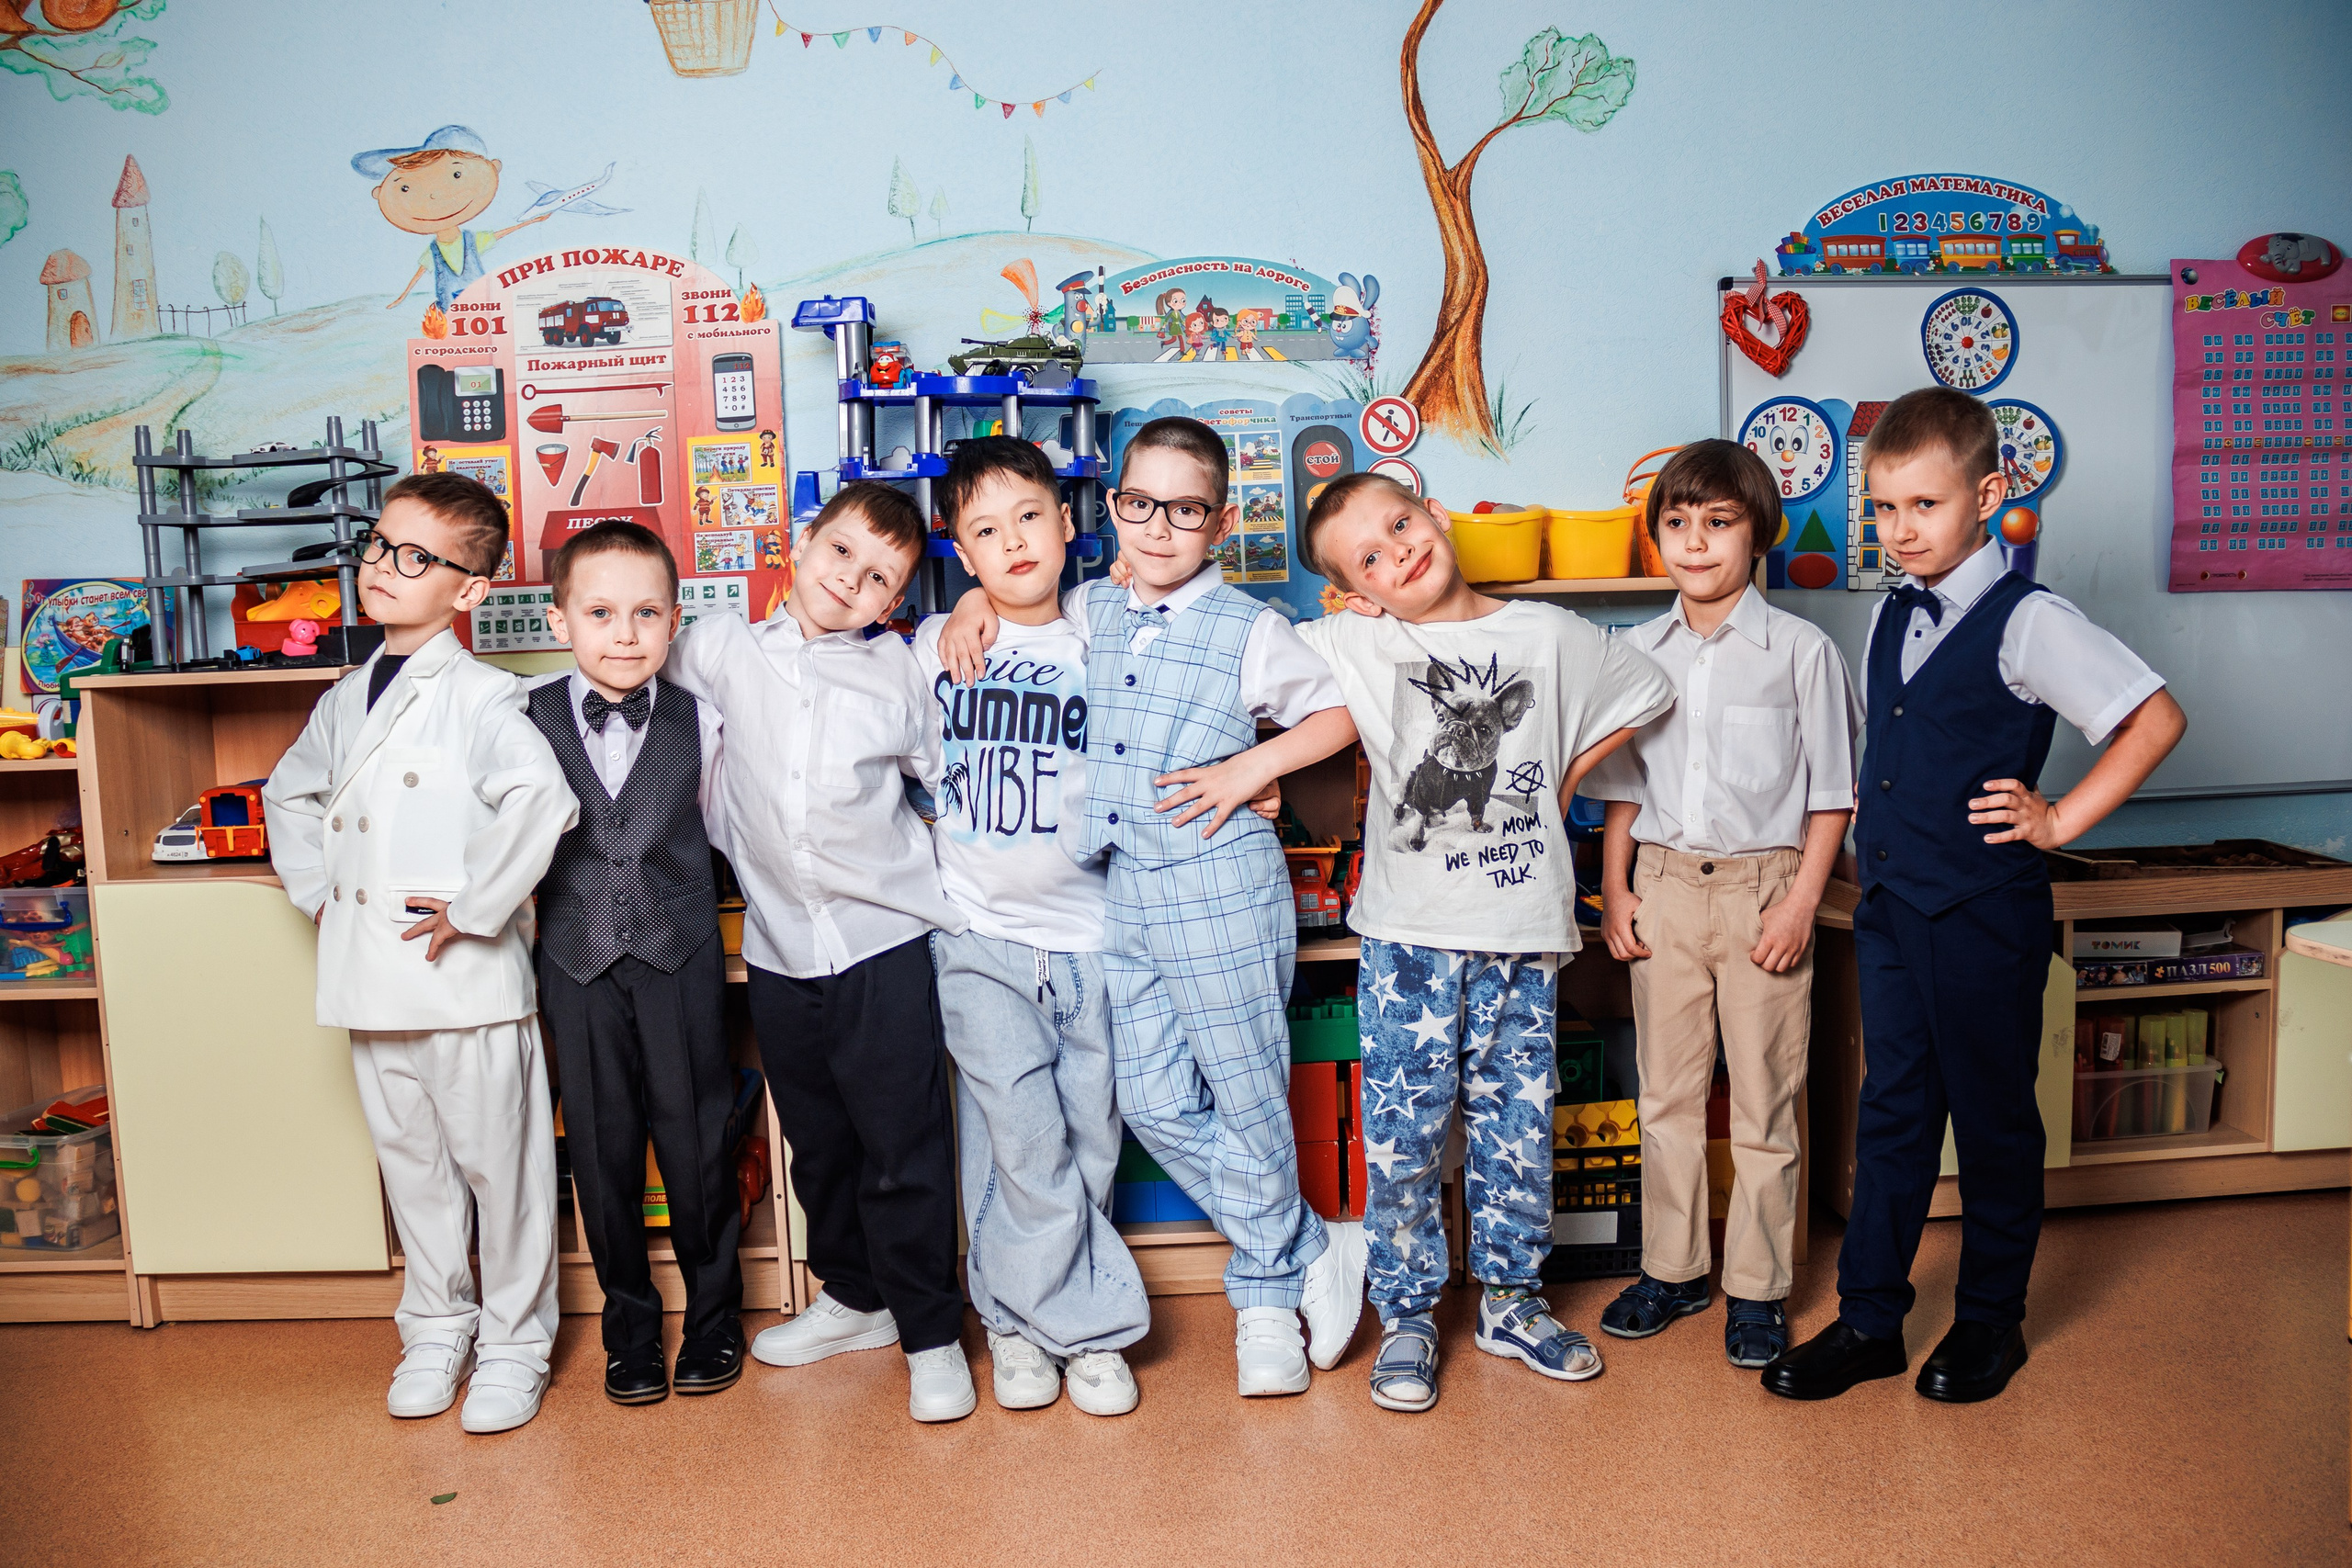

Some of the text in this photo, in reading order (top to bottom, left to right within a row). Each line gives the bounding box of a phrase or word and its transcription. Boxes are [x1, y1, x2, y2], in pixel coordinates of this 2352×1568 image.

[1816, 177, 2047, 228] ВЕСЕЛАЯ МАТЕМАТИКА
[497, 248, 685, 288] ПРИ ПОЖАРЕ
[1120, 261, 1310, 295] Безопасность на дороге
[2185, 287, 2285, 312] ВЕСЁЛЫЙ
[683, 303, 740, 324] 112
[2260, 307, 2316, 328] СЧЁТ
[451, 316, 508, 336] 101
[698, 327, 771, 338] мобильного
[425, 346, 498, 356] городского
[527, 355, 667, 371] Пожарный щит
[1964, 358, 1971, 368] 5
[1290, 413, 1352, 423] Транспортный
[1763, 413, 1775, 425] 11
[1779, 407, 1797, 422] 12
[1803, 413, 1810, 426] 1
[1752, 426, 1766, 438] 10
[1815, 425, 1824, 438] 2
[1306, 453, 1340, 464] СТОЙ
[1820, 443, 1831, 459] 3
[1814, 464, 1823, 477] 4
[1781, 480, 1792, 495] 6
[1801, 478, 1810, 490] 5
[35, 593, 46, 604] От
[48, 595, 78, 608] улыбки
[81, 593, 107, 605] станет
[111, 591, 130, 600] всем
[964, 746, 1058, 836] VIBE
[1445, 839, 1544, 871] WE NEED TO
[2091, 940, 2141, 950] ТОМИК
[2166, 964, 2207, 977] ПАЗЛ
[2209, 962, 2231, 974] 500
